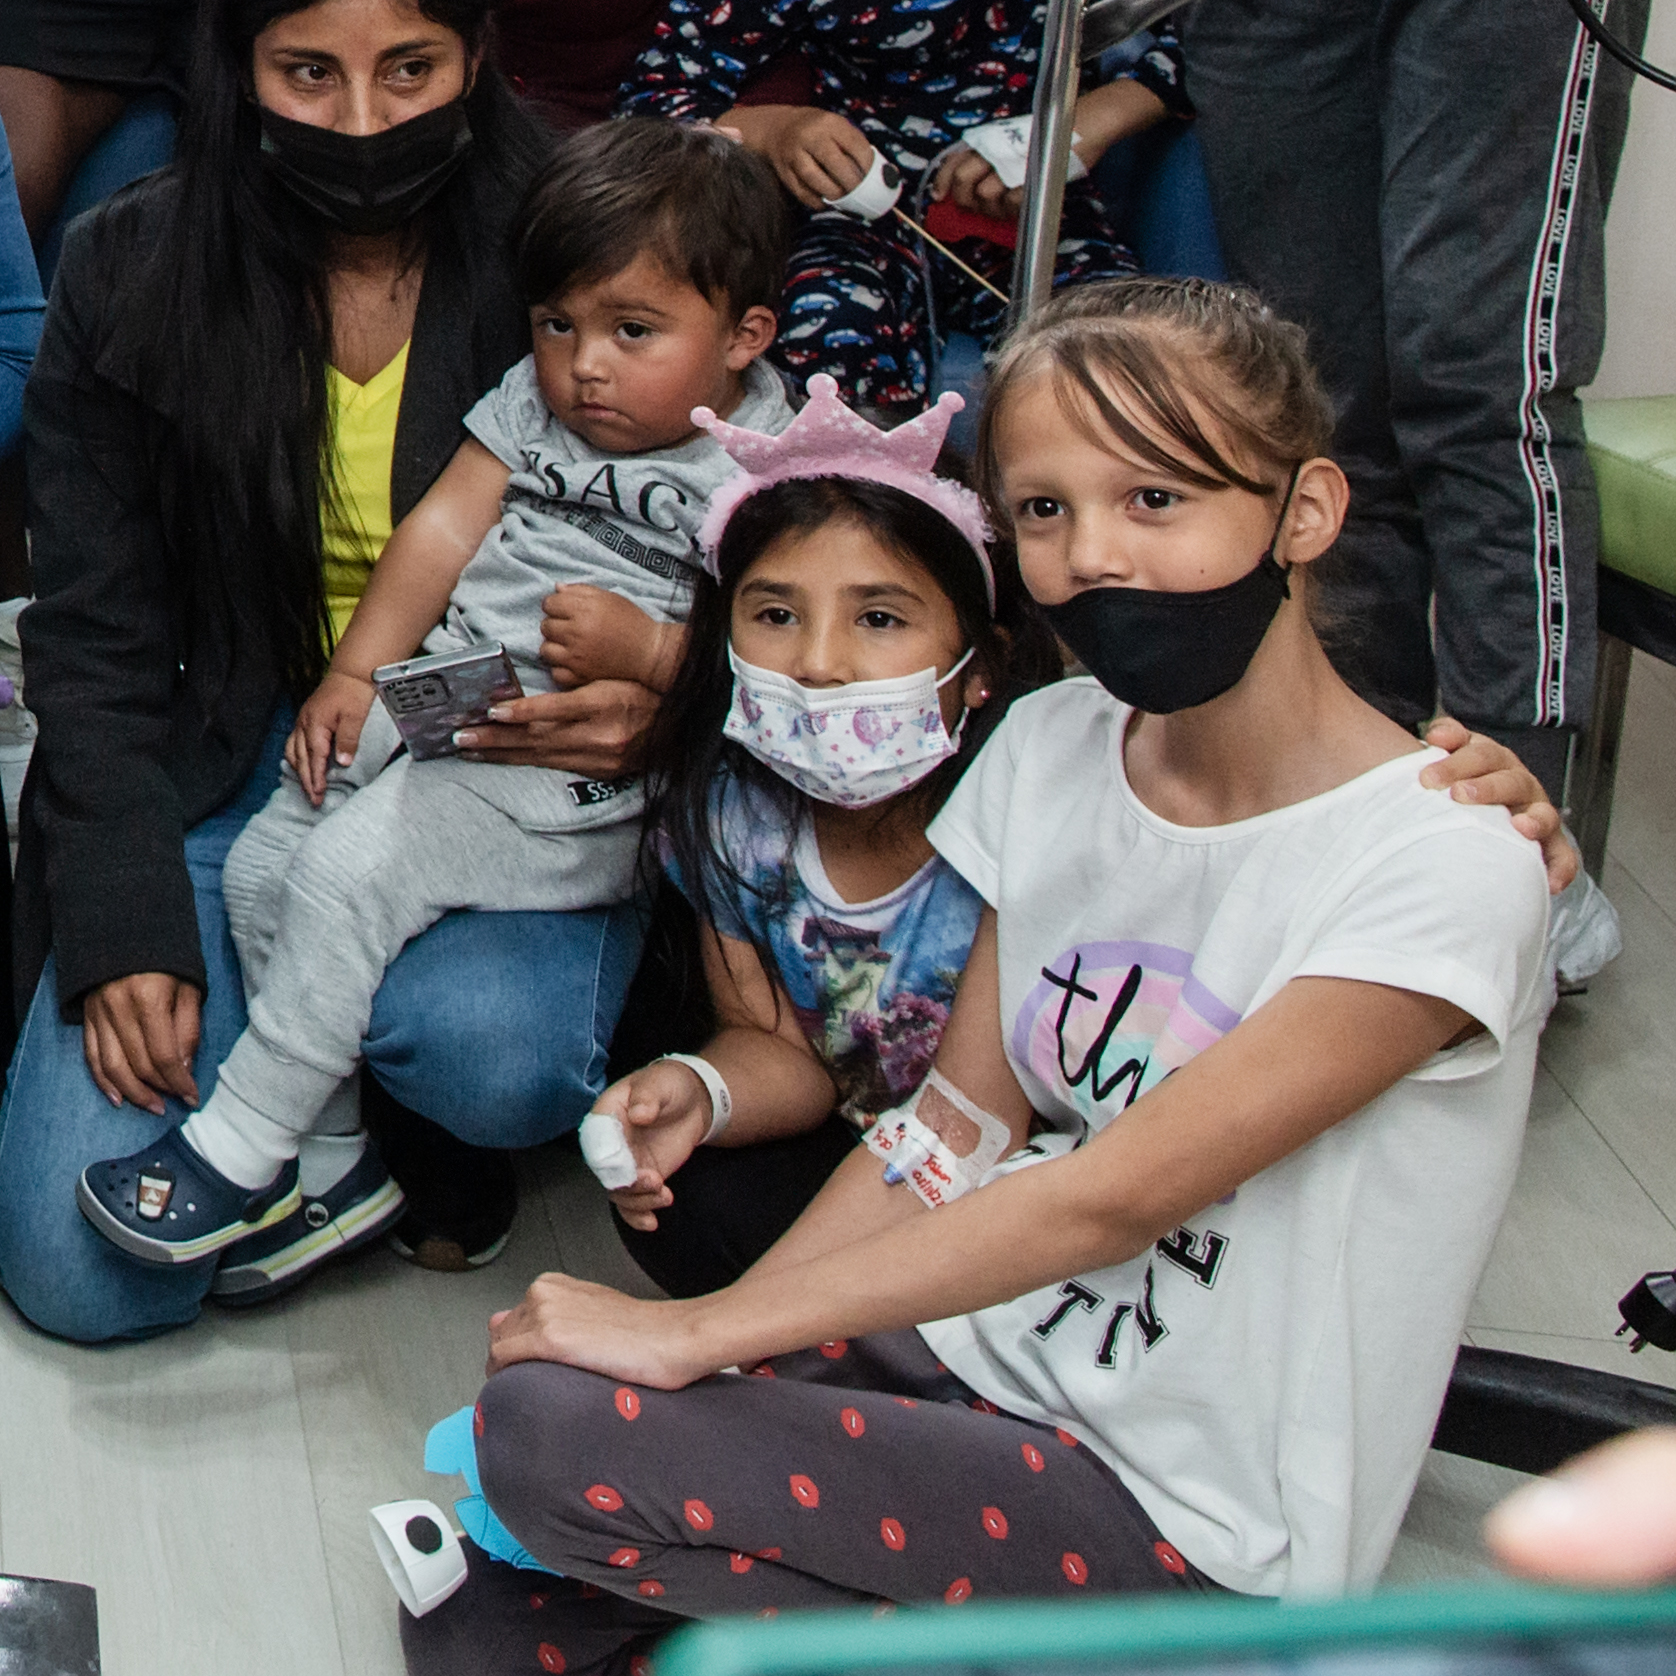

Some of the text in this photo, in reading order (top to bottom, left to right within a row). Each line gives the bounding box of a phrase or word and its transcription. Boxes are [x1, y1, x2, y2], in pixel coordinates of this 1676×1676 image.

[1572, 99, 1586, 135] LOVE
[1562, 154, 1577, 188] LOVE
[1553, 208, 1567, 243] LOVE
[1543, 263, 1558, 297] LOVE
[1539, 319, 1551, 353] LOVE
[1548, 511, 1558, 545] LOVE
[1550, 566, 1562, 603] LOVE
[1550, 624, 1562, 661] LOVE
[1550, 680, 1561, 717] LOVE
